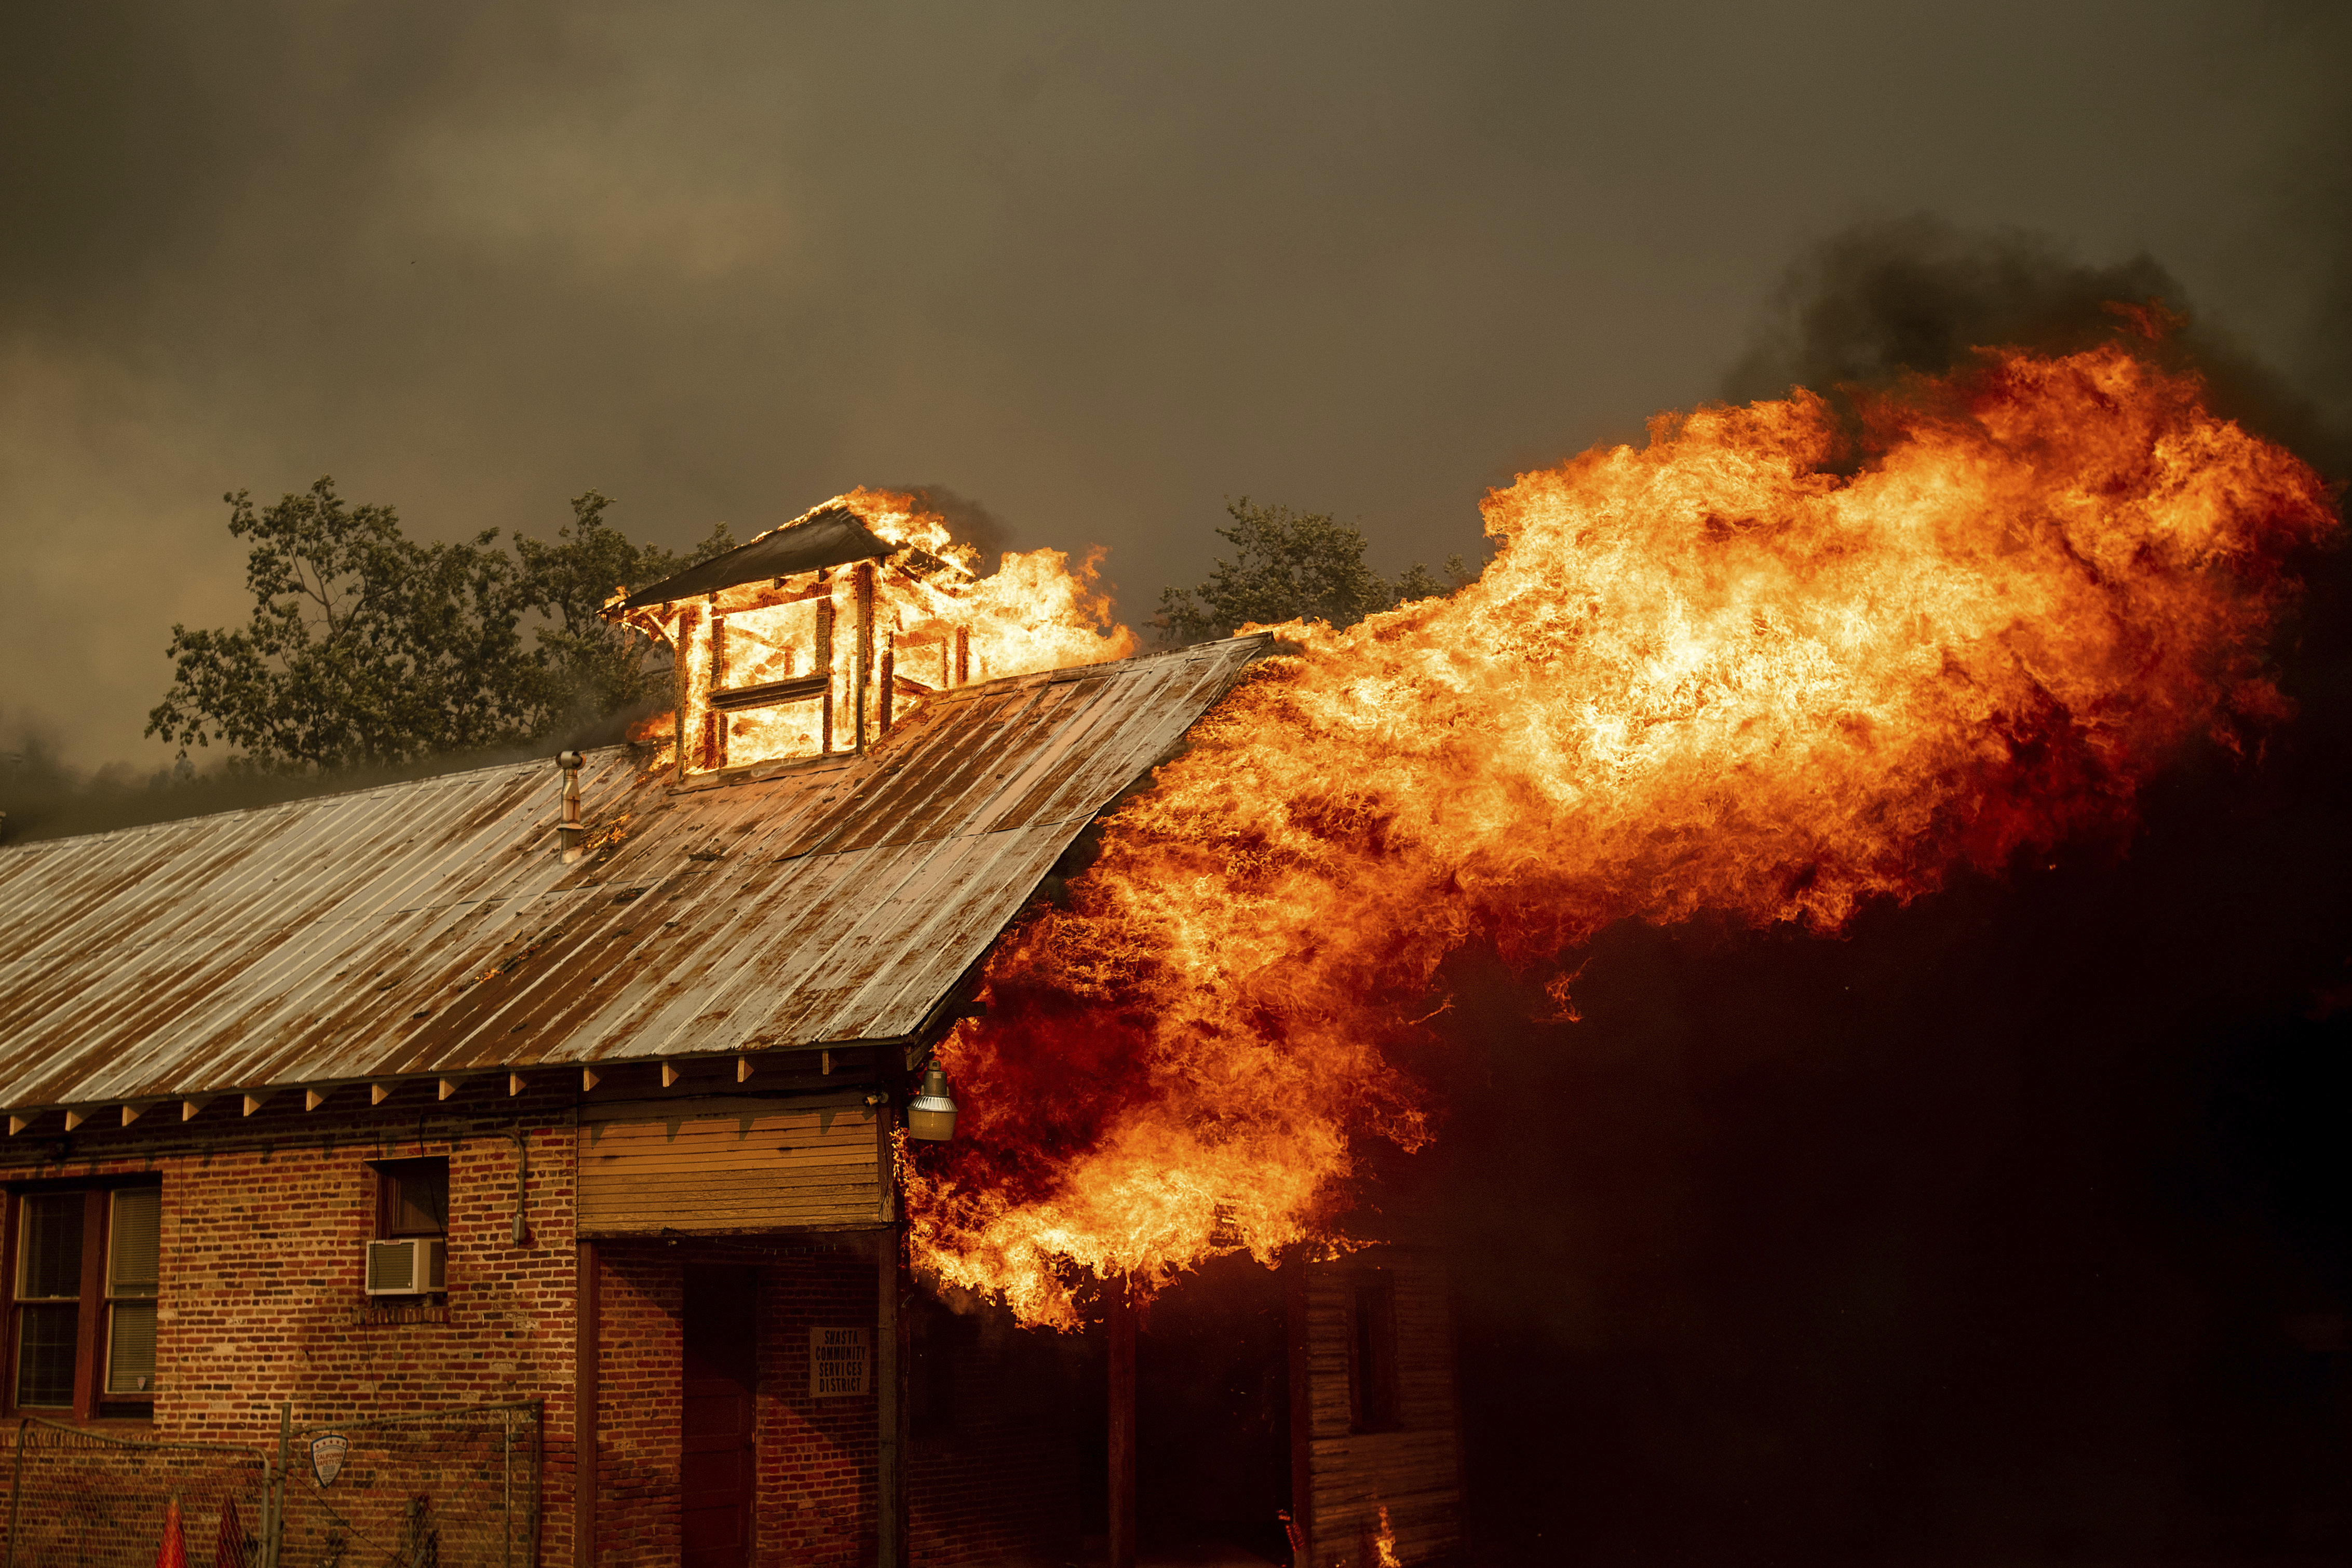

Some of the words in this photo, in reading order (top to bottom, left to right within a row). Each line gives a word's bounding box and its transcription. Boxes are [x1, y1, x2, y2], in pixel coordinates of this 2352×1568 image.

[824, 1330, 858, 1345] SHASTA
[816, 1346, 866, 1361] COMMUNITY
[819, 1361, 862, 1377] SERVICES
[819, 1377, 861, 1393] DISTRICT
